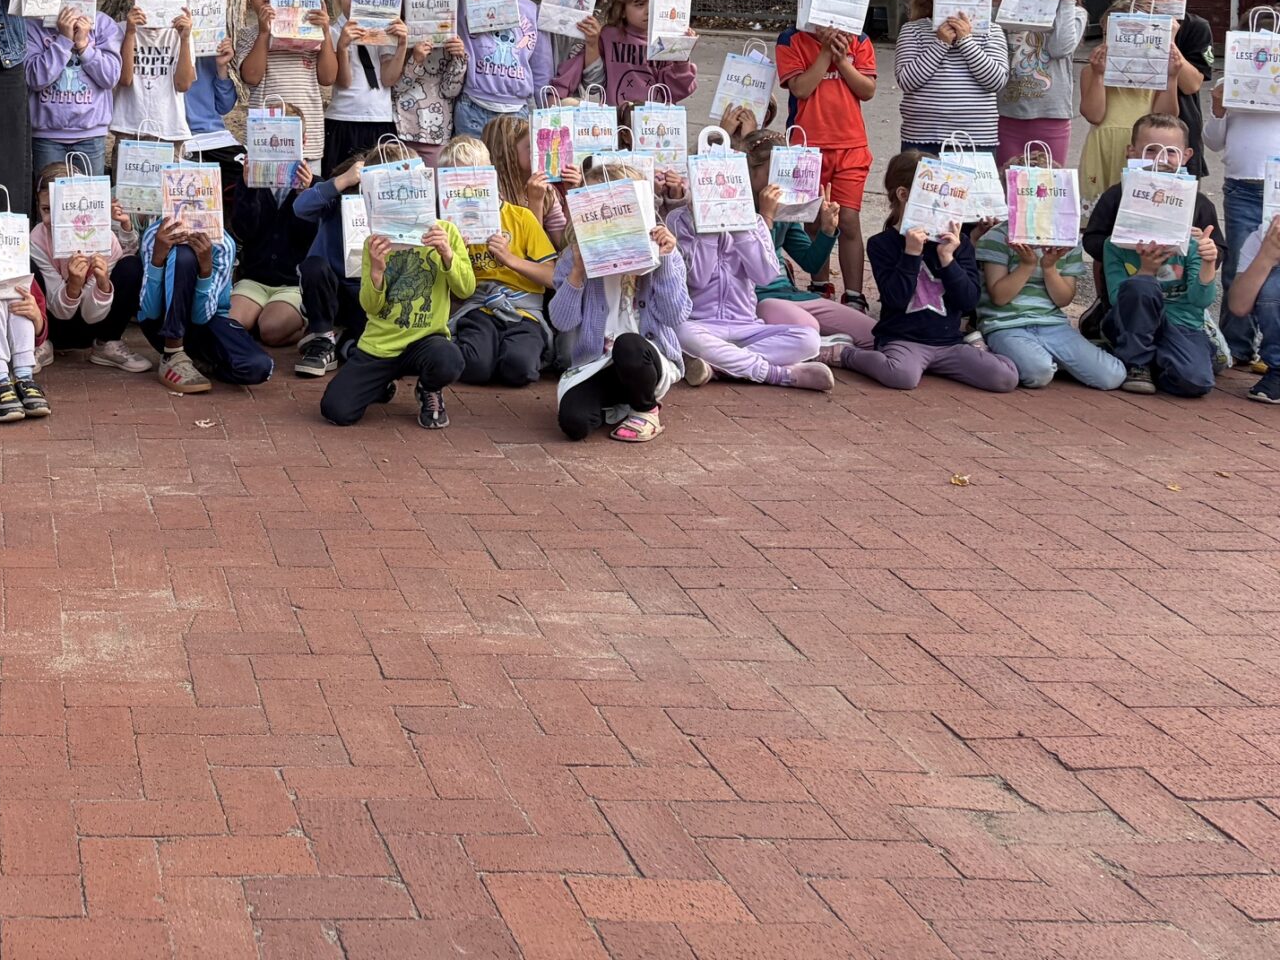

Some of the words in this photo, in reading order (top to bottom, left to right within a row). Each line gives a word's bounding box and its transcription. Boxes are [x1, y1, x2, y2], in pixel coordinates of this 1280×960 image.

[190, 9, 200, 17] ESE
[133, 55, 175, 66] ROPEZ
[1236, 51, 1254, 60] LESE
[475, 59, 525, 81] STITCH
[40, 88, 93, 105] STITCH
[378, 191, 395, 200] LESE
[410, 189, 427, 199] TÜTE
[1017, 187, 1034, 196] LESE
[1049, 186, 1067, 198] TÜTE
[1132, 188, 1151, 200] LESE
[1165, 194, 1184, 208] TÜTE
[62, 202, 77, 211] LESE
[581, 211, 598, 223] LESE
